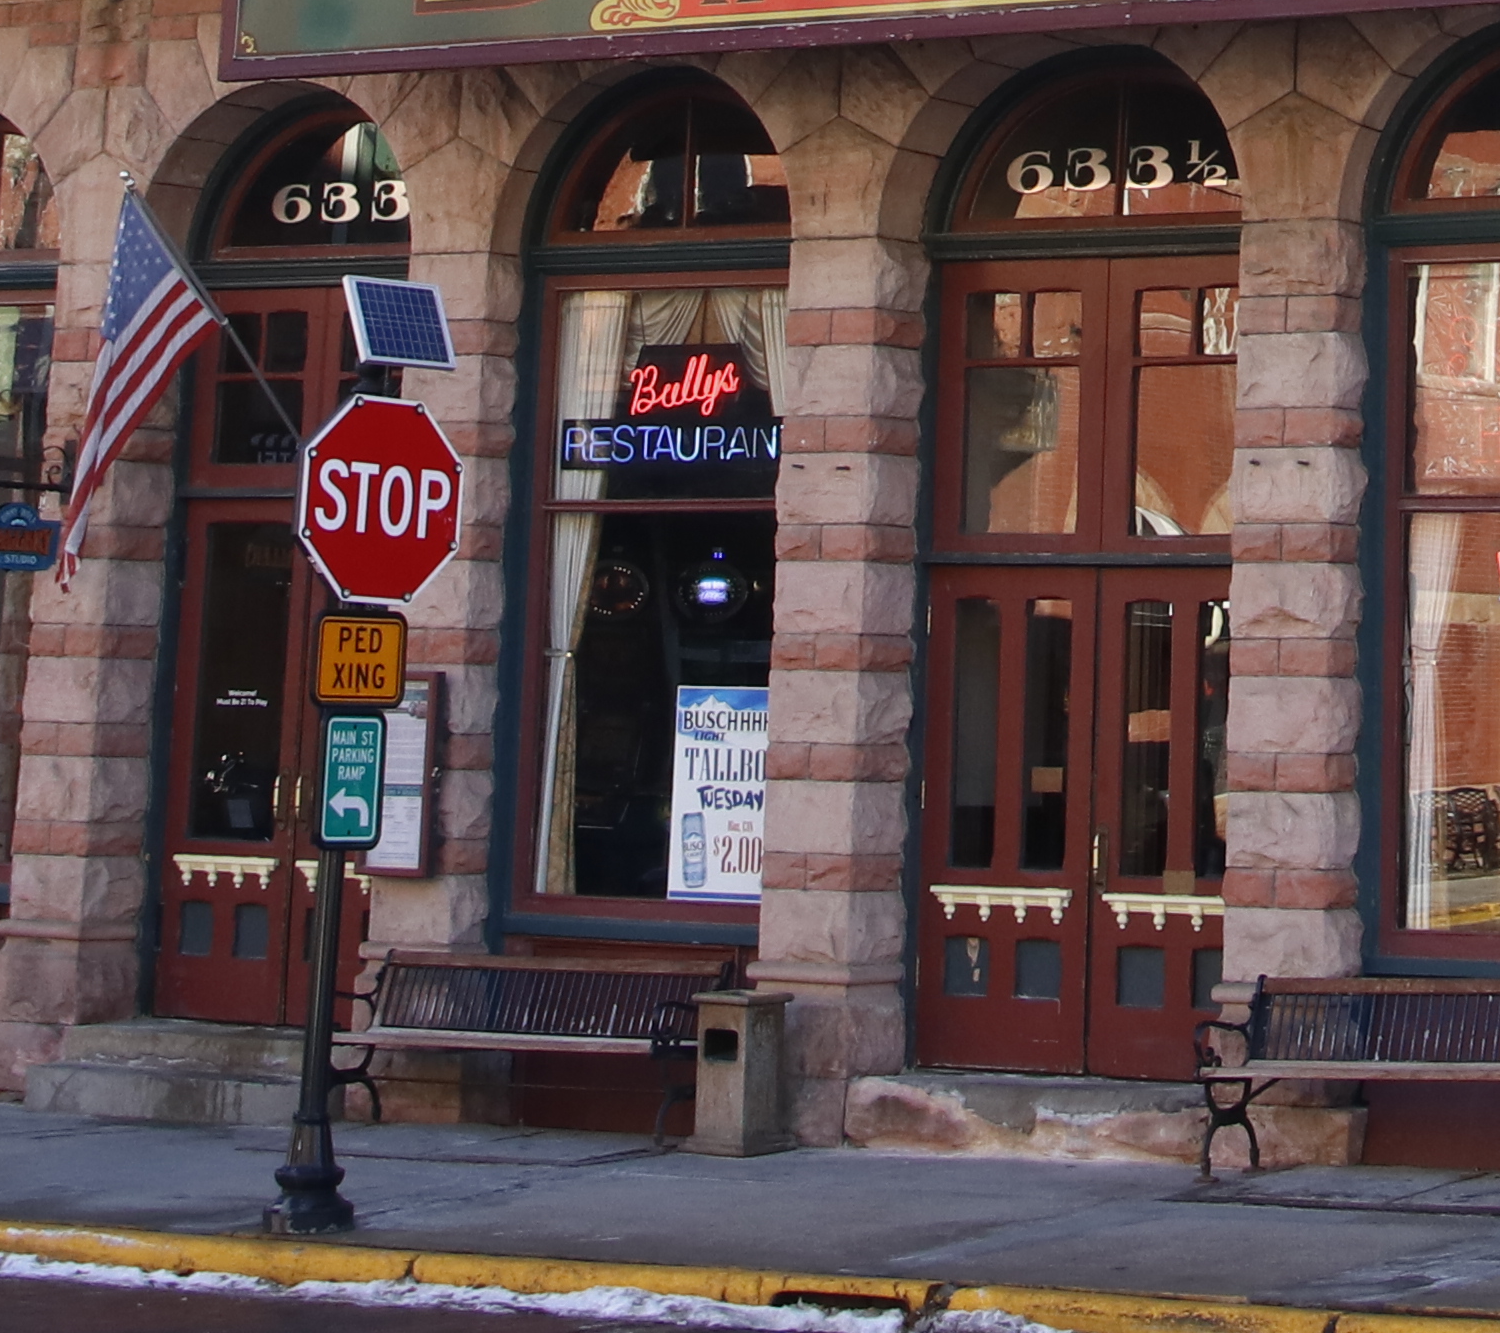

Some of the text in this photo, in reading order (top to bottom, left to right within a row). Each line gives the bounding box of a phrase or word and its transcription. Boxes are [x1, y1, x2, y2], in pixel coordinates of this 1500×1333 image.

[1006, 145, 1174, 195] 633
[271, 179, 410, 224] 633
[564, 424, 785, 463] RESTAURAN
[314, 458, 451, 539] STOP
[3, 553, 38, 565] STUDIO
[338, 626, 383, 654] PED
[332, 663, 386, 690] XING
[332, 731, 357, 745] MAIN
[694, 732, 726, 742] LIGHT
[331, 747, 375, 763] PARKING
[337, 765, 366, 781] RAMP
[696, 785, 764, 812] TUESDAY
[712, 835, 763, 875] $2.00
